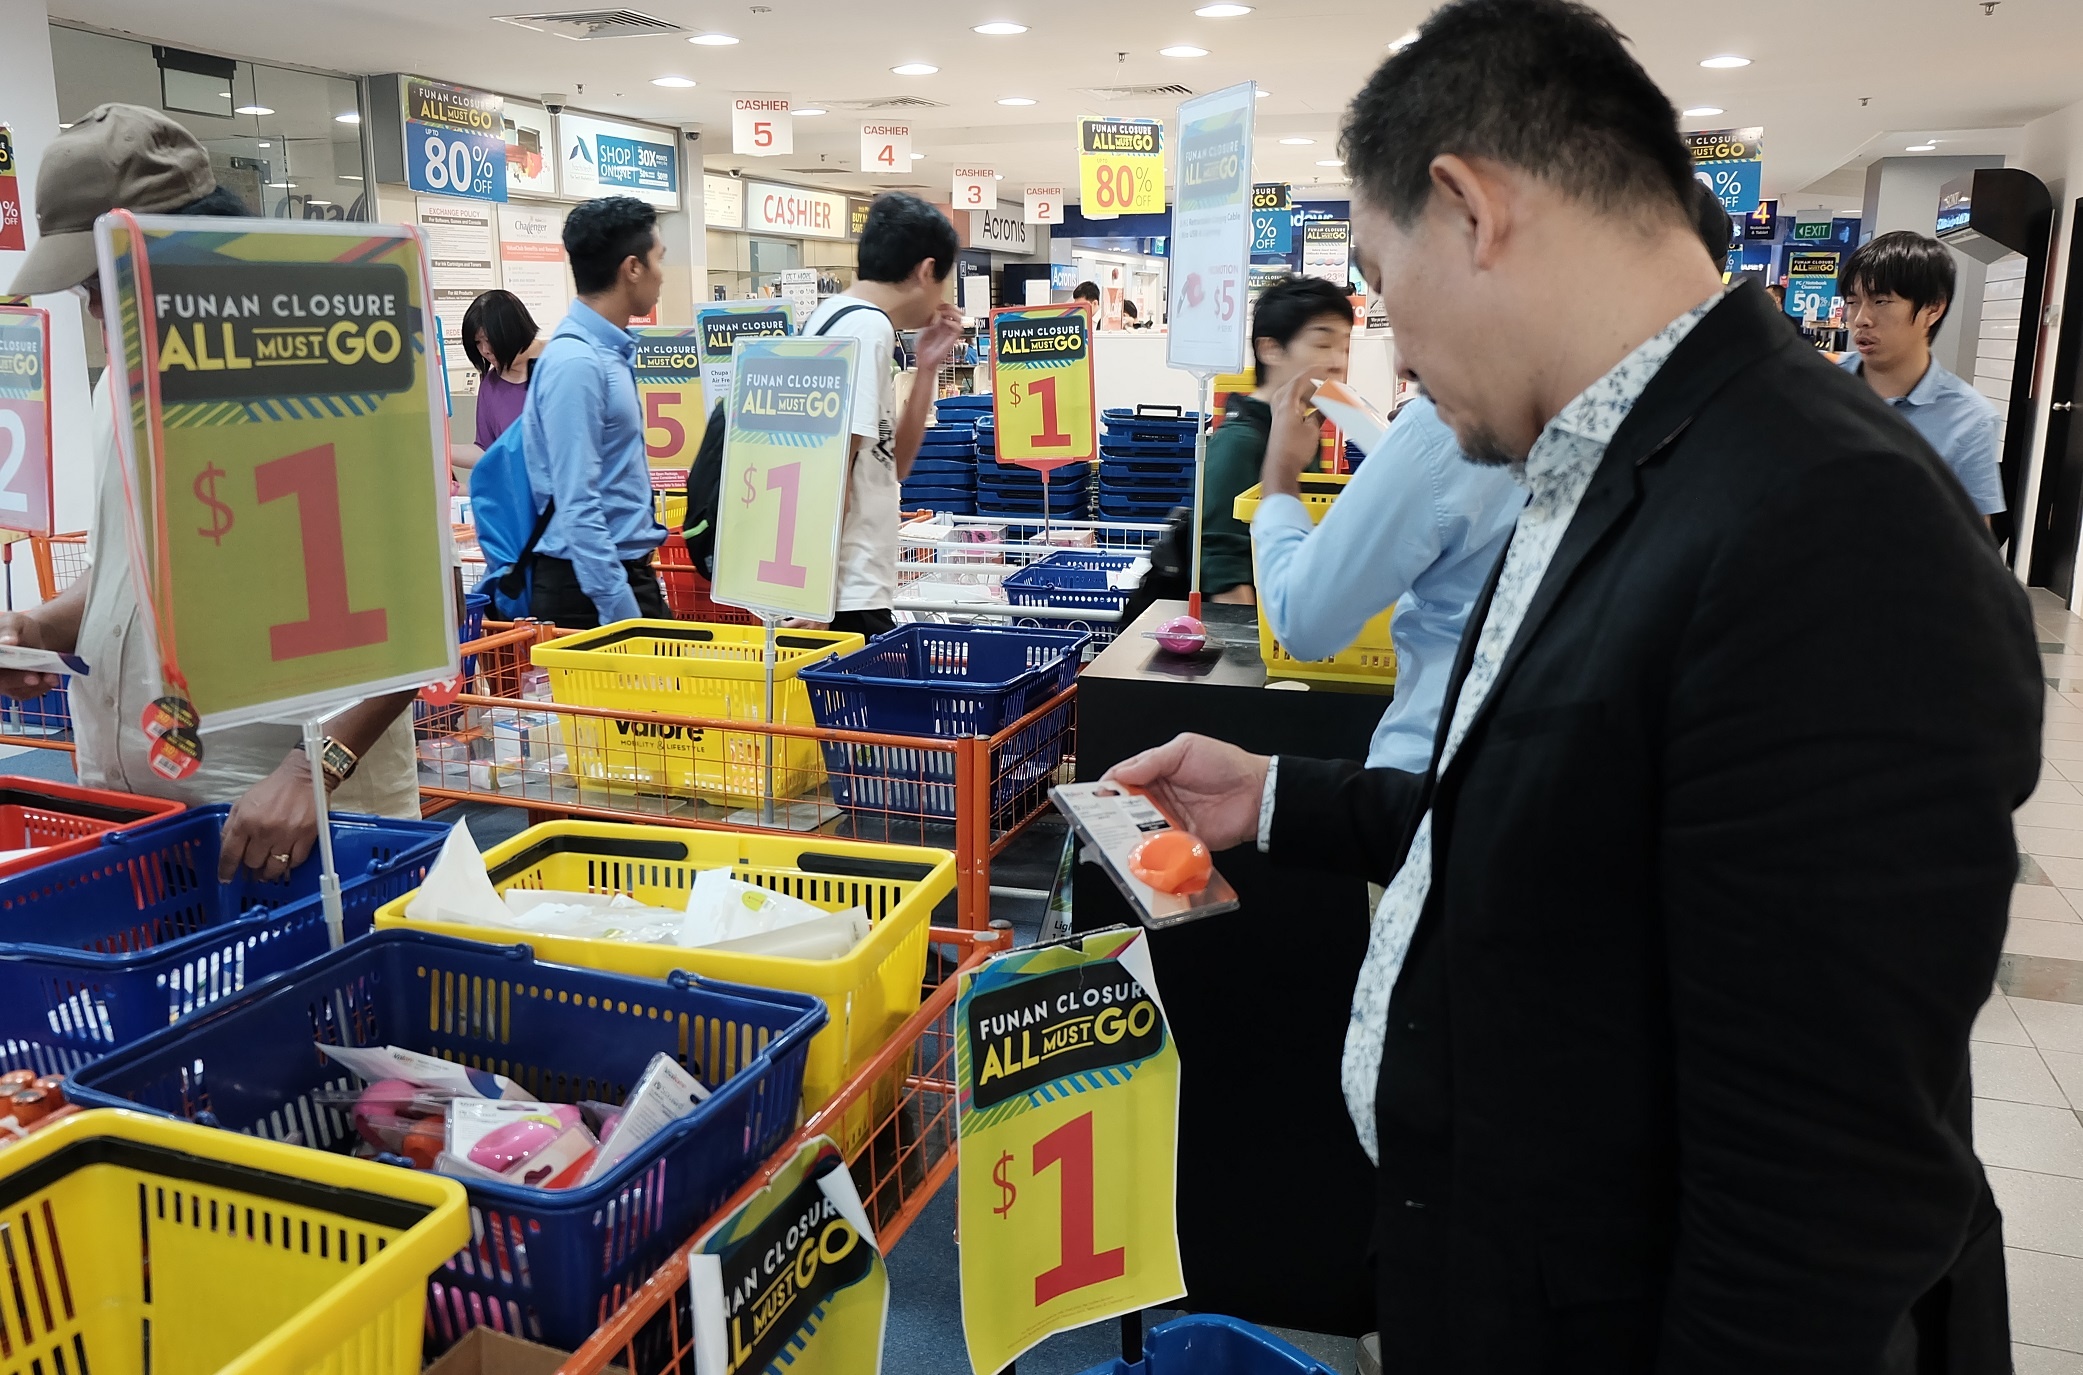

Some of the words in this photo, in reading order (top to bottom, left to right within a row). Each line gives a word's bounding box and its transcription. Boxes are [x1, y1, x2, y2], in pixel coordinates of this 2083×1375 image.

[419, 87, 449, 102] FUNAN
[452, 95, 490, 110] CLOSUR
[735, 99, 789, 111] CASHIER
[420, 100, 447, 121] ALL
[448, 108, 469, 121] MUST
[469, 108, 492, 130] GO
[425, 128, 432, 136] UP
[432, 129, 439, 137] TO
[754, 122, 773, 147] 5
[863, 125, 909, 136] CASHIER
[1091, 123, 1117, 133] FUNAN
[1119, 125, 1152, 135] CLOSURE
[1092, 132, 1116, 150] ALL
[1115, 137, 1133, 147] MUST
[1132, 134, 1153, 151] GO
[1696, 135, 1738, 145] CLOSUR
[600, 144, 631, 165] SHOP
[638, 148, 657, 167] 30X
[877, 144, 895, 166] 4
[1185, 149, 1207, 162] FUNAN
[1715, 142, 1745, 158] GO
[955, 168, 994, 178] CASHIER
[1185, 161, 1202, 186] ALL
[1219, 154, 1238, 179] GO
[473, 178, 493, 195] OFF
[967, 185, 982, 204] 3
[1026, 187, 1061, 195] CASHIER
[1135, 194, 1151, 207] OFF
[1253, 194, 1278, 207] GO
[429, 207, 459, 217] EXCHANGE
[460, 209, 480, 218] POLICY
[763, 194, 831, 229] CA$HIER
[1037, 202, 1051, 219] 2
[1751, 202, 1771, 225] 4
[4, 217, 18, 226] OFF
[982, 209, 1026, 243] Acronis
[1306, 232, 1322, 240] ALL
[1332, 232, 1346, 240] GO
[1804, 225, 1828, 237] EXIT
[1256, 239, 1276, 249] OFF
[1051, 267, 1078, 287] Acronis
[155, 294, 261, 319] FUNAN
[271, 292, 396, 318] CLOSURE
[1213, 279, 1235, 321] $5
[707, 322, 739, 332] FUNAN
[742, 320, 784, 330] CLOSURE
[1001, 326, 1034, 339] FUNAN
[1037, 325, 1080, 336] CLOSURE
[159, 321, 253, 372] ALL
[256, 334, 324, 360] MUST
[326, 319, 401, 366] GO
[708, 331, 734, 348] ALL
[1001, 336, 1030, 355] ALL
[1031, 339, 1053, 350] MUST
[1054, 334, 1082, 351] GO
[653, 345, 696, 354] CLOSURE
[13, 353, 38, 376] GO
[647, 358, 670, 366] MUST
[670, 353, 698, 369] GO
[746, 373, 784, 388] FUNAN
[787, 373, 841, 390] CLOSURE
[741, 389, 777, 416] ALL
[778, 397, 807, 412] MUST
[806, 390, 840, 419] GO
[978, 1001, 1049, 1041] FUNAN
[1056, 980, 1149, 1015] CLOSUR
[979, 1033, 1041, 1087] ALL
[1042, 1021, 1092, 1054] MUST
[1093, 999, 1157, 1046] GO
[752, 1270, 797, 1337] MUST
[794, 1217, 860, 1290] GO
